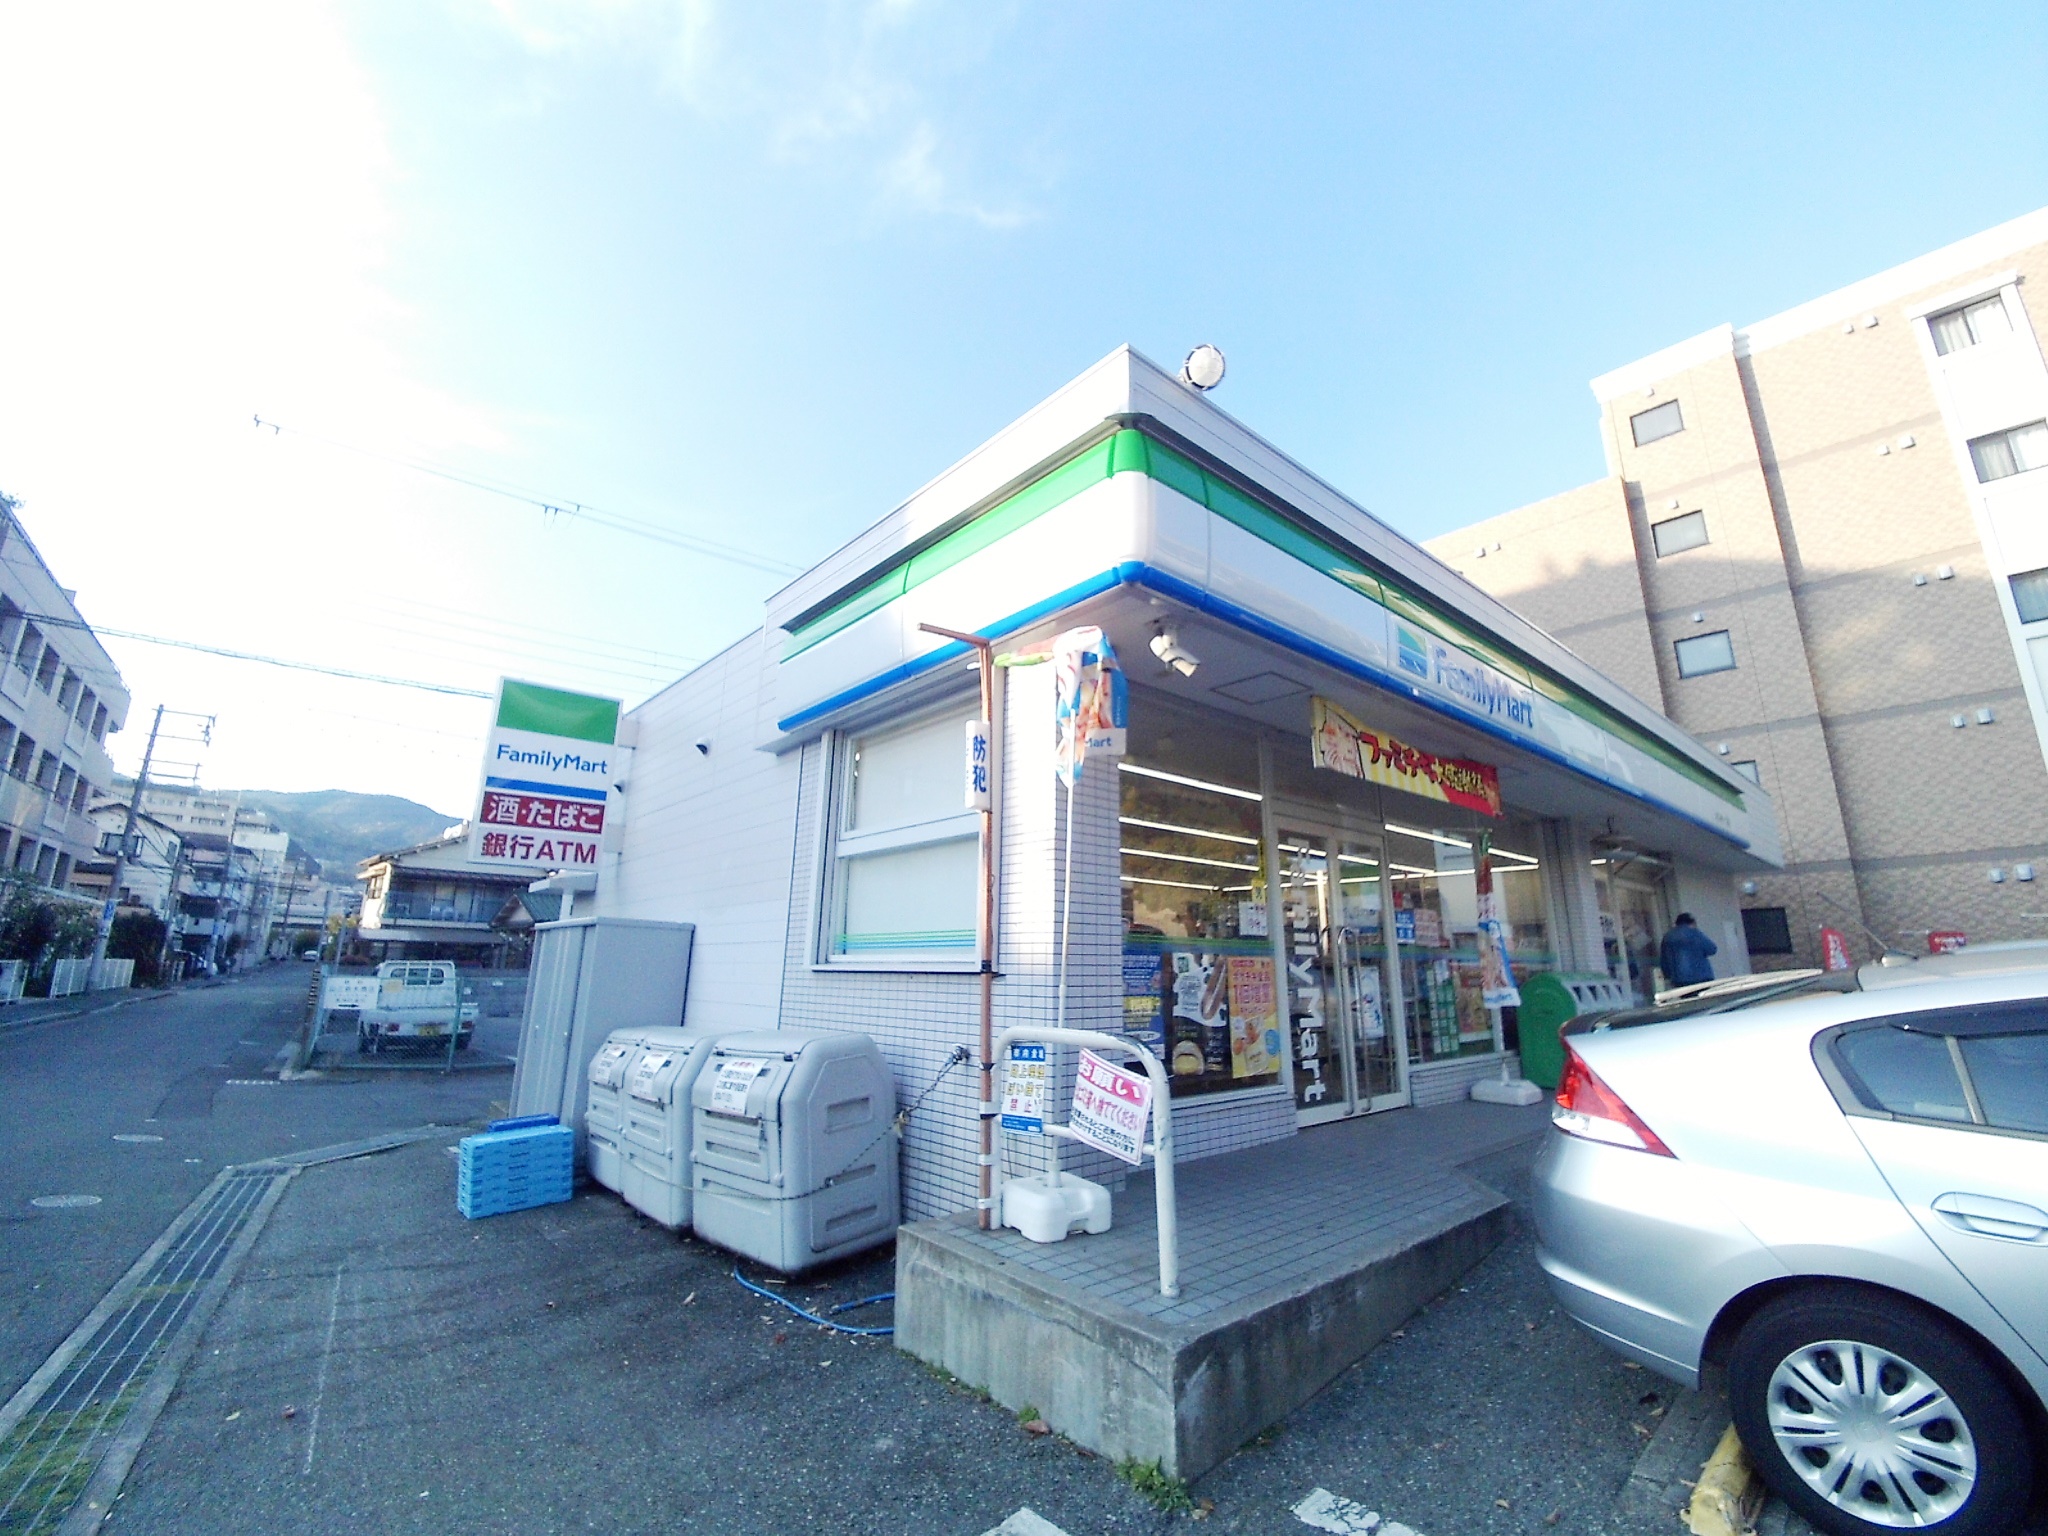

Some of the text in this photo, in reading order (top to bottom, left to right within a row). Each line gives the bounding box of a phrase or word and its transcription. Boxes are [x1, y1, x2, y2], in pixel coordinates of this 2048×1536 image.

[1436, 646, 1533, 728] FamilyMart
[497, 744, 607, 774] FamilyMart
[973, 734, 987, 793] 防犯
[487, 795, 600, 830] 酒・たばこ
[480, 831, 597, 864] 銀行ATM
[1078, 1057, 1141, 1100] お願い
